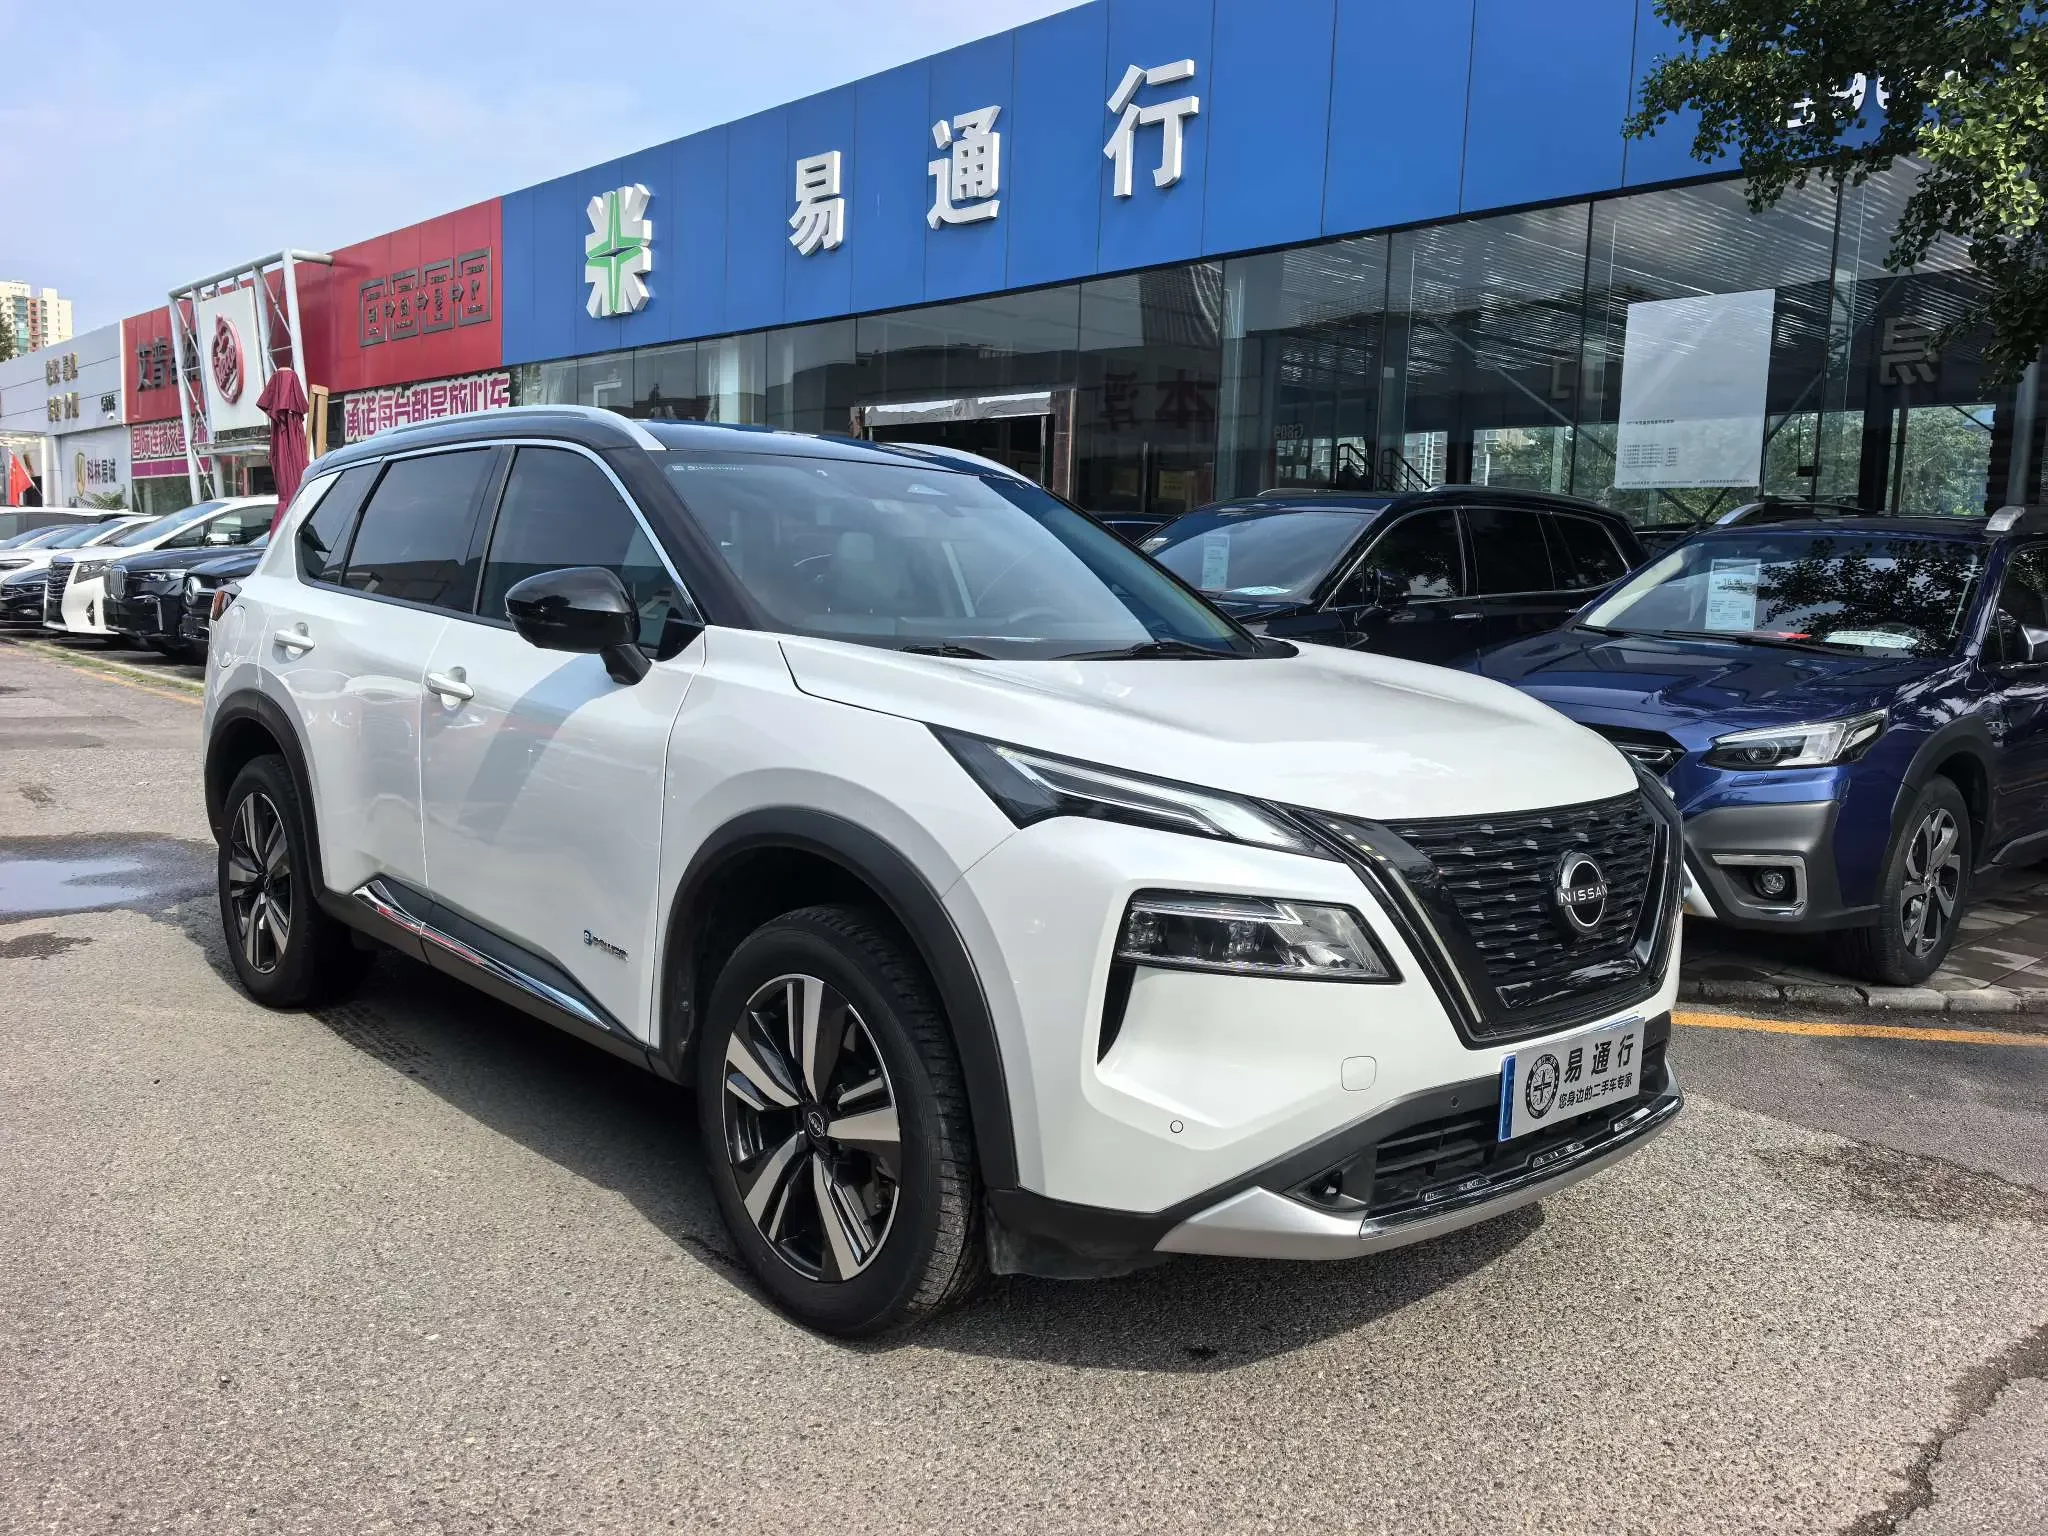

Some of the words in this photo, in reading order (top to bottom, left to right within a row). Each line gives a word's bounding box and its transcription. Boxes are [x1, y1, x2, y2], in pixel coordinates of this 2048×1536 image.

[789, 58, 1200, 257] 易通行
[1560, 883, 1608, 904] NISSAN
[1563, 1033, 1635, 1084] 易通行
[1558, 1072, 1633, 1110] 您身边的二手车专家
